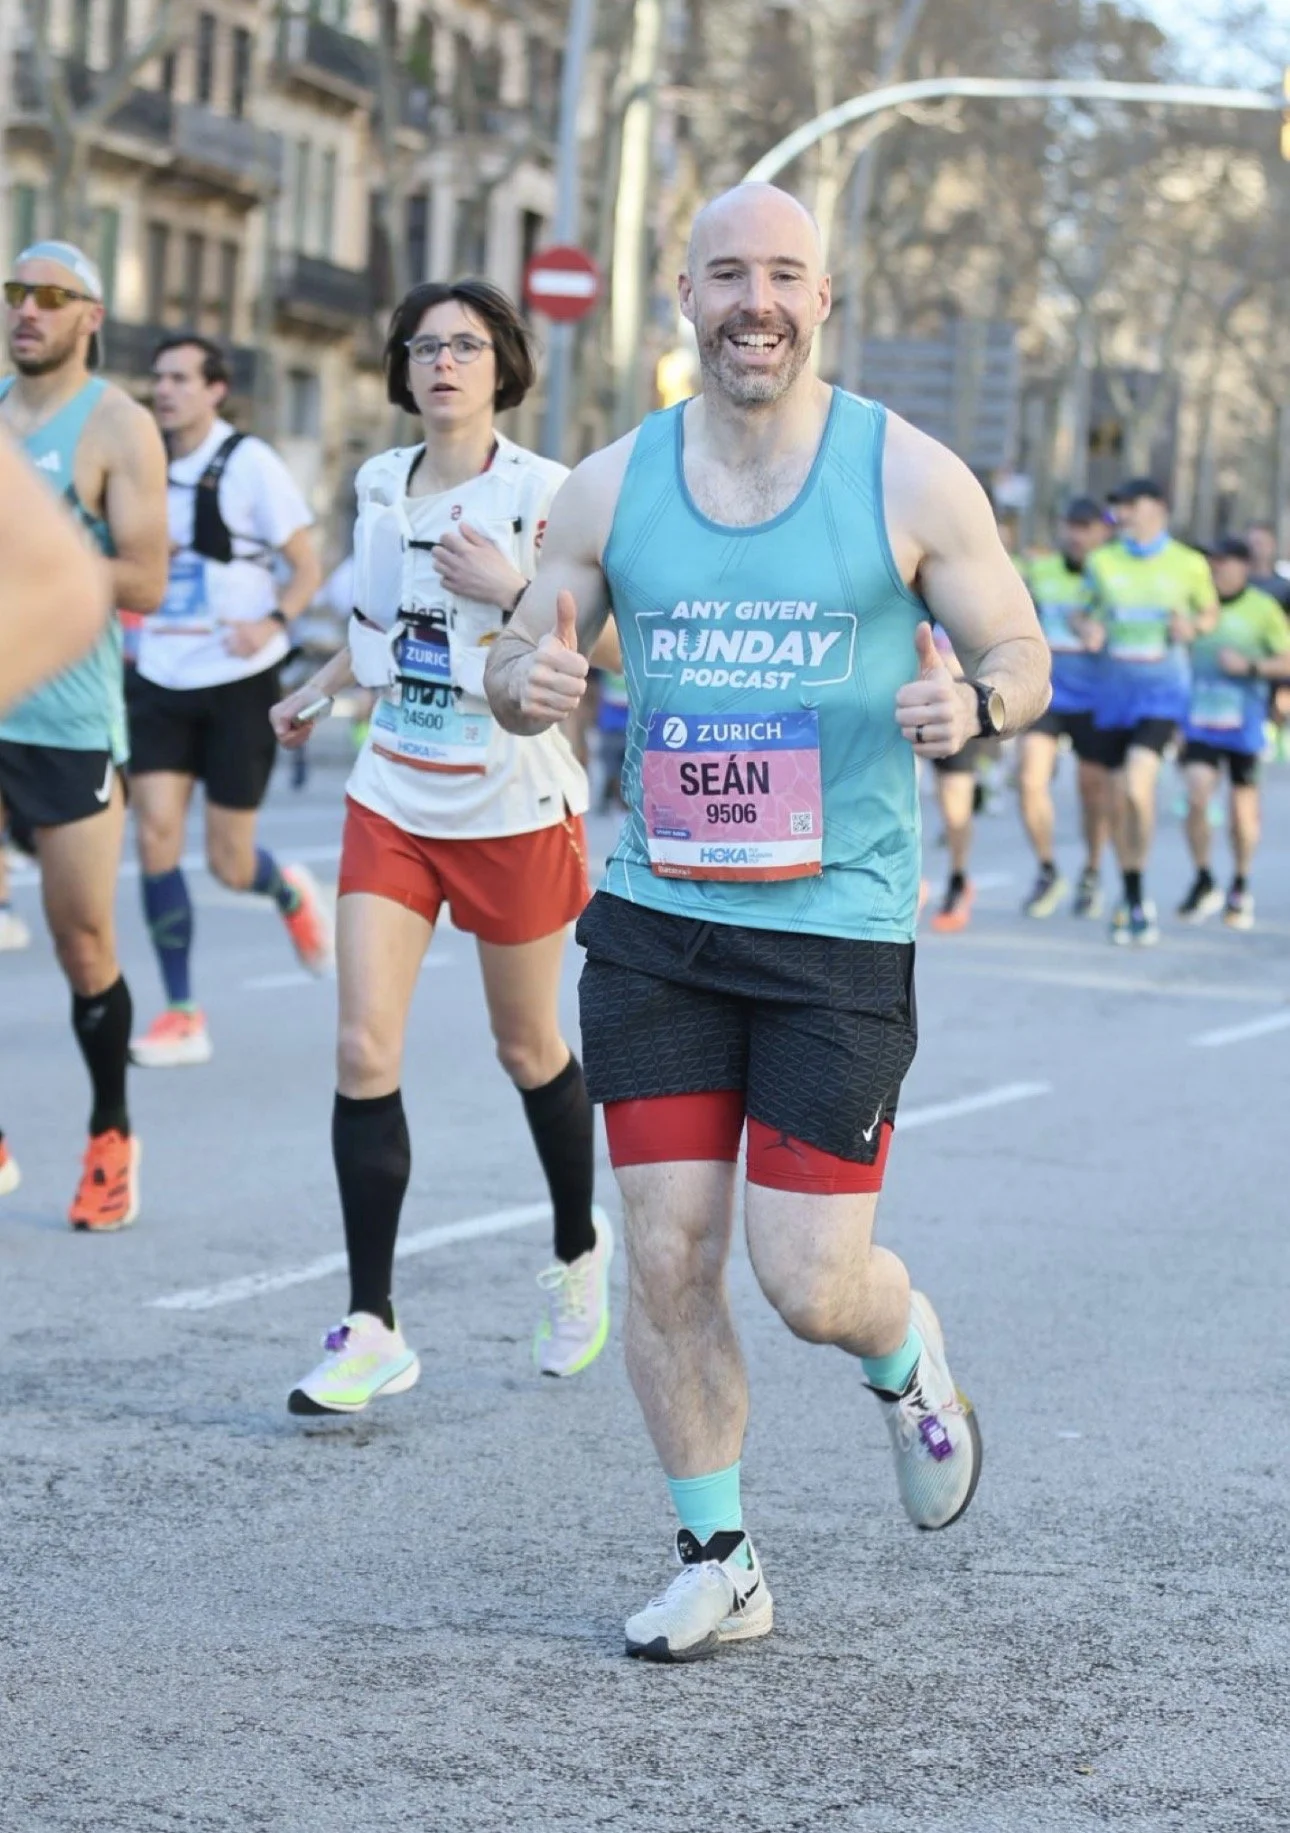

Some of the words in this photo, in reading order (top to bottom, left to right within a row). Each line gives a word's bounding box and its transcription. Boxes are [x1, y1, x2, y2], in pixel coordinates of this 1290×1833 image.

[671, 601, 731, 620] ANY
[735, 601, 818, 621] GIVEN
[406, 646, 449, 668] ZURIC
[651, 628, 842, 667] RUNDAY
[680, 668, 796, 690] PODCAST
[697, 722, 783, 742] ZURICH
[680, 755, 770, 796] SEÁN
[706, 803, 757, 824] 9506
[699, 847, 748, 864] HOKA
